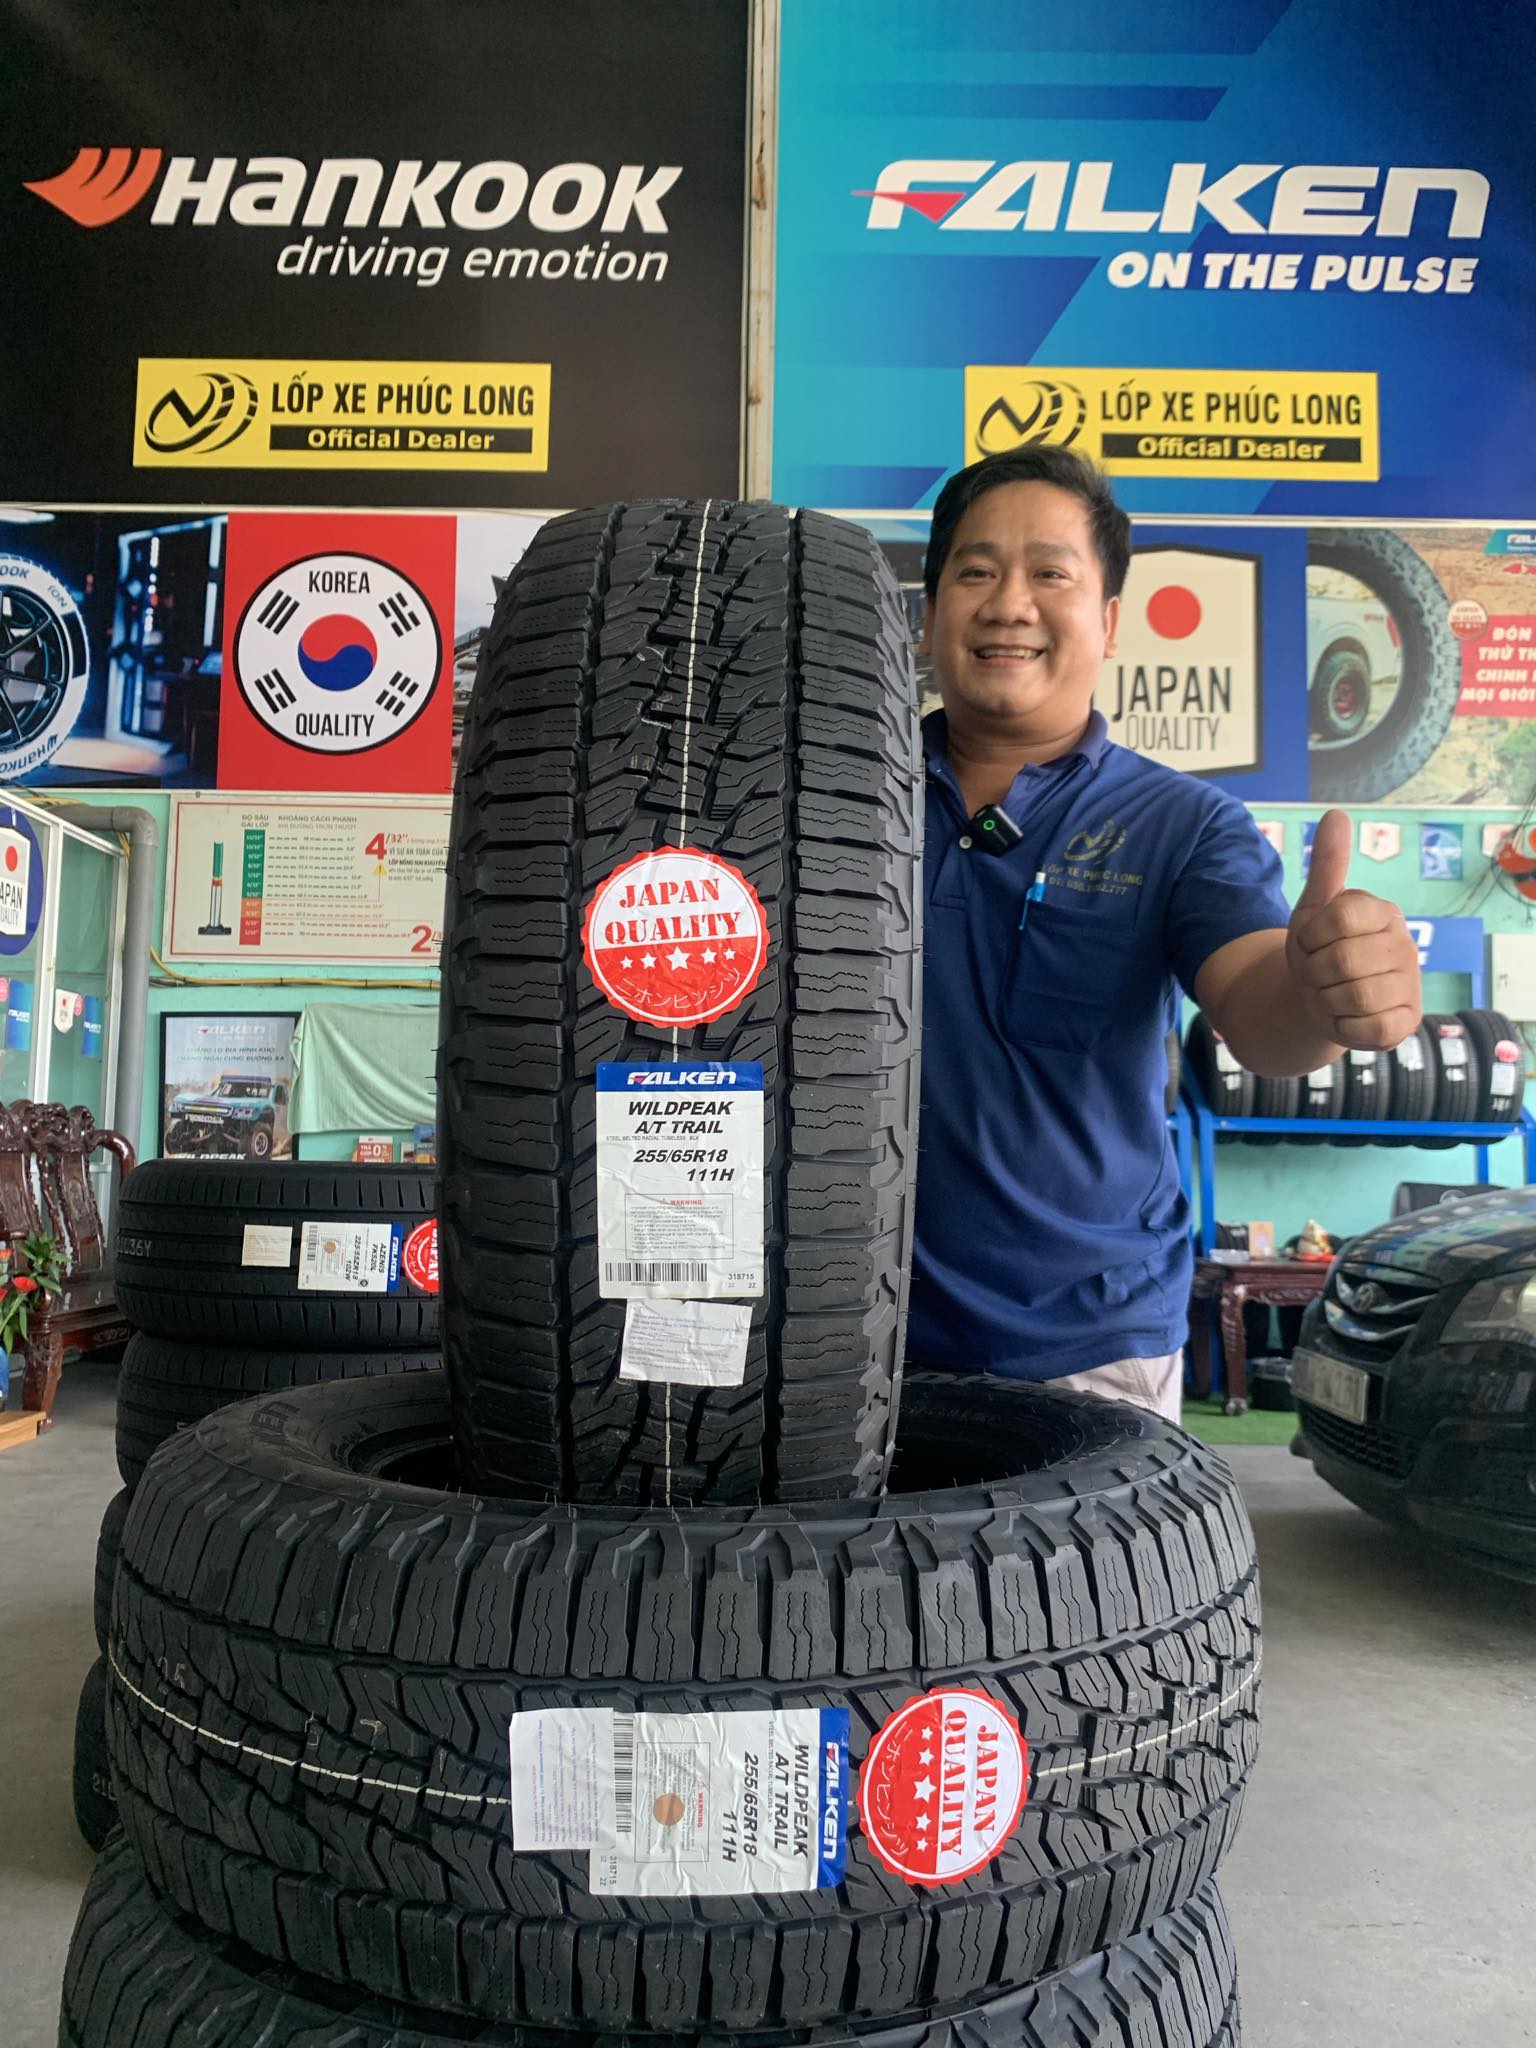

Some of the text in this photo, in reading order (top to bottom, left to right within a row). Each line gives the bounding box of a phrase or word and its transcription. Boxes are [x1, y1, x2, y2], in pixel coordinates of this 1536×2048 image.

[866, 159, 1491, 239] FALKEN
[277, 235, 669, 286] driving emotion
[1108, 252, 1480, 295] ON THE PULSE
[272, 370, 535, 417] LỐP XE PHÚC LONG
[1101, 379, 1362, 426] LỐP XE PHÚC LONG
[307, 429, 495, 451] Official Dealer
[1138, 437, 1326, 461] Official Dealer
[308, 570, 370, 594] KOREA
[1112, 665, 1232, 722] JAPAN
[296, 713, 375, 738] QUALITY
[1126, 714, 1220, 750] QUALITY
[619, 879, 719, 908] JAPAN
[605, 912, 741, 945] QUALITY
[627, 1071, 737, 1085] FALKEN
[628, 1101, 734, 1116] WILDPEAK
[635, 1120, 724, 1134] A/T TRAIL
[633, 1150, 728, 1163] 255/65R18
[687, 1168, 735, 1181] 111H
[378, 1242, 387, 1274] AZENIS
[390, 1236, 399, 1282] FALKEN
[941, 1709, 967, 1856] QUALITY
[974, 1724, 999, 1832] JAPAN
[743, 1750, 759, 1857] 255/65R18
[774, 1752, 790, 1849] A/T TRAIL
[793, 1744, 809, 1859] WILDPEAK
[823, 1741, 840, 1860] FALKEN
[722, 1810, 737, 1863] 111H
[609, 1855, 617, 1885] 318715
